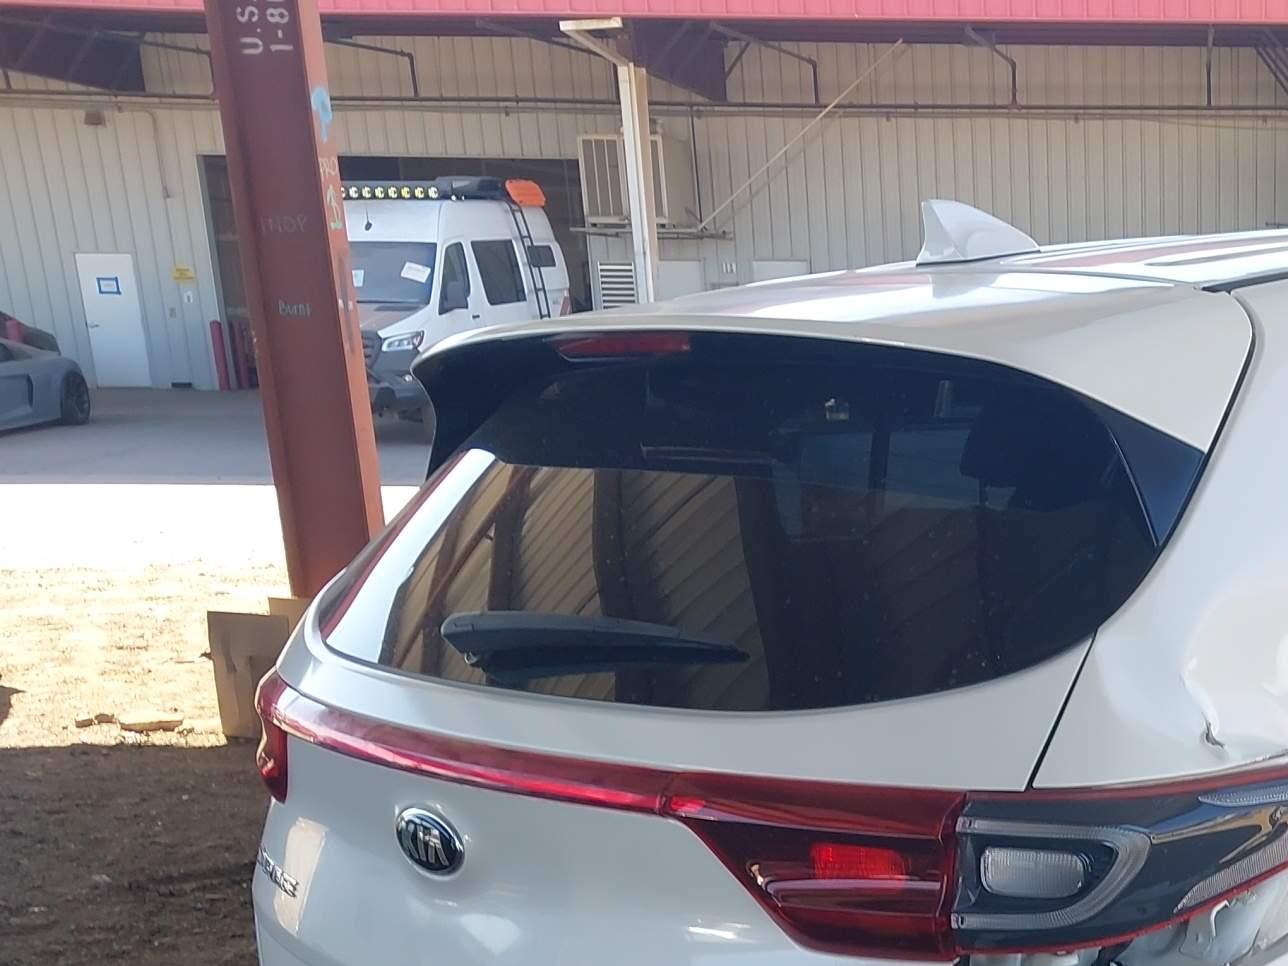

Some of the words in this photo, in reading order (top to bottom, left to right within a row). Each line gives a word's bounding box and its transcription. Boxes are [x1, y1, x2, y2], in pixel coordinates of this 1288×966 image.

[236, 0, 264, 54] U.S
[265, 0, 294, 52] 1-8
[398, 819, 449, 865] KIA
